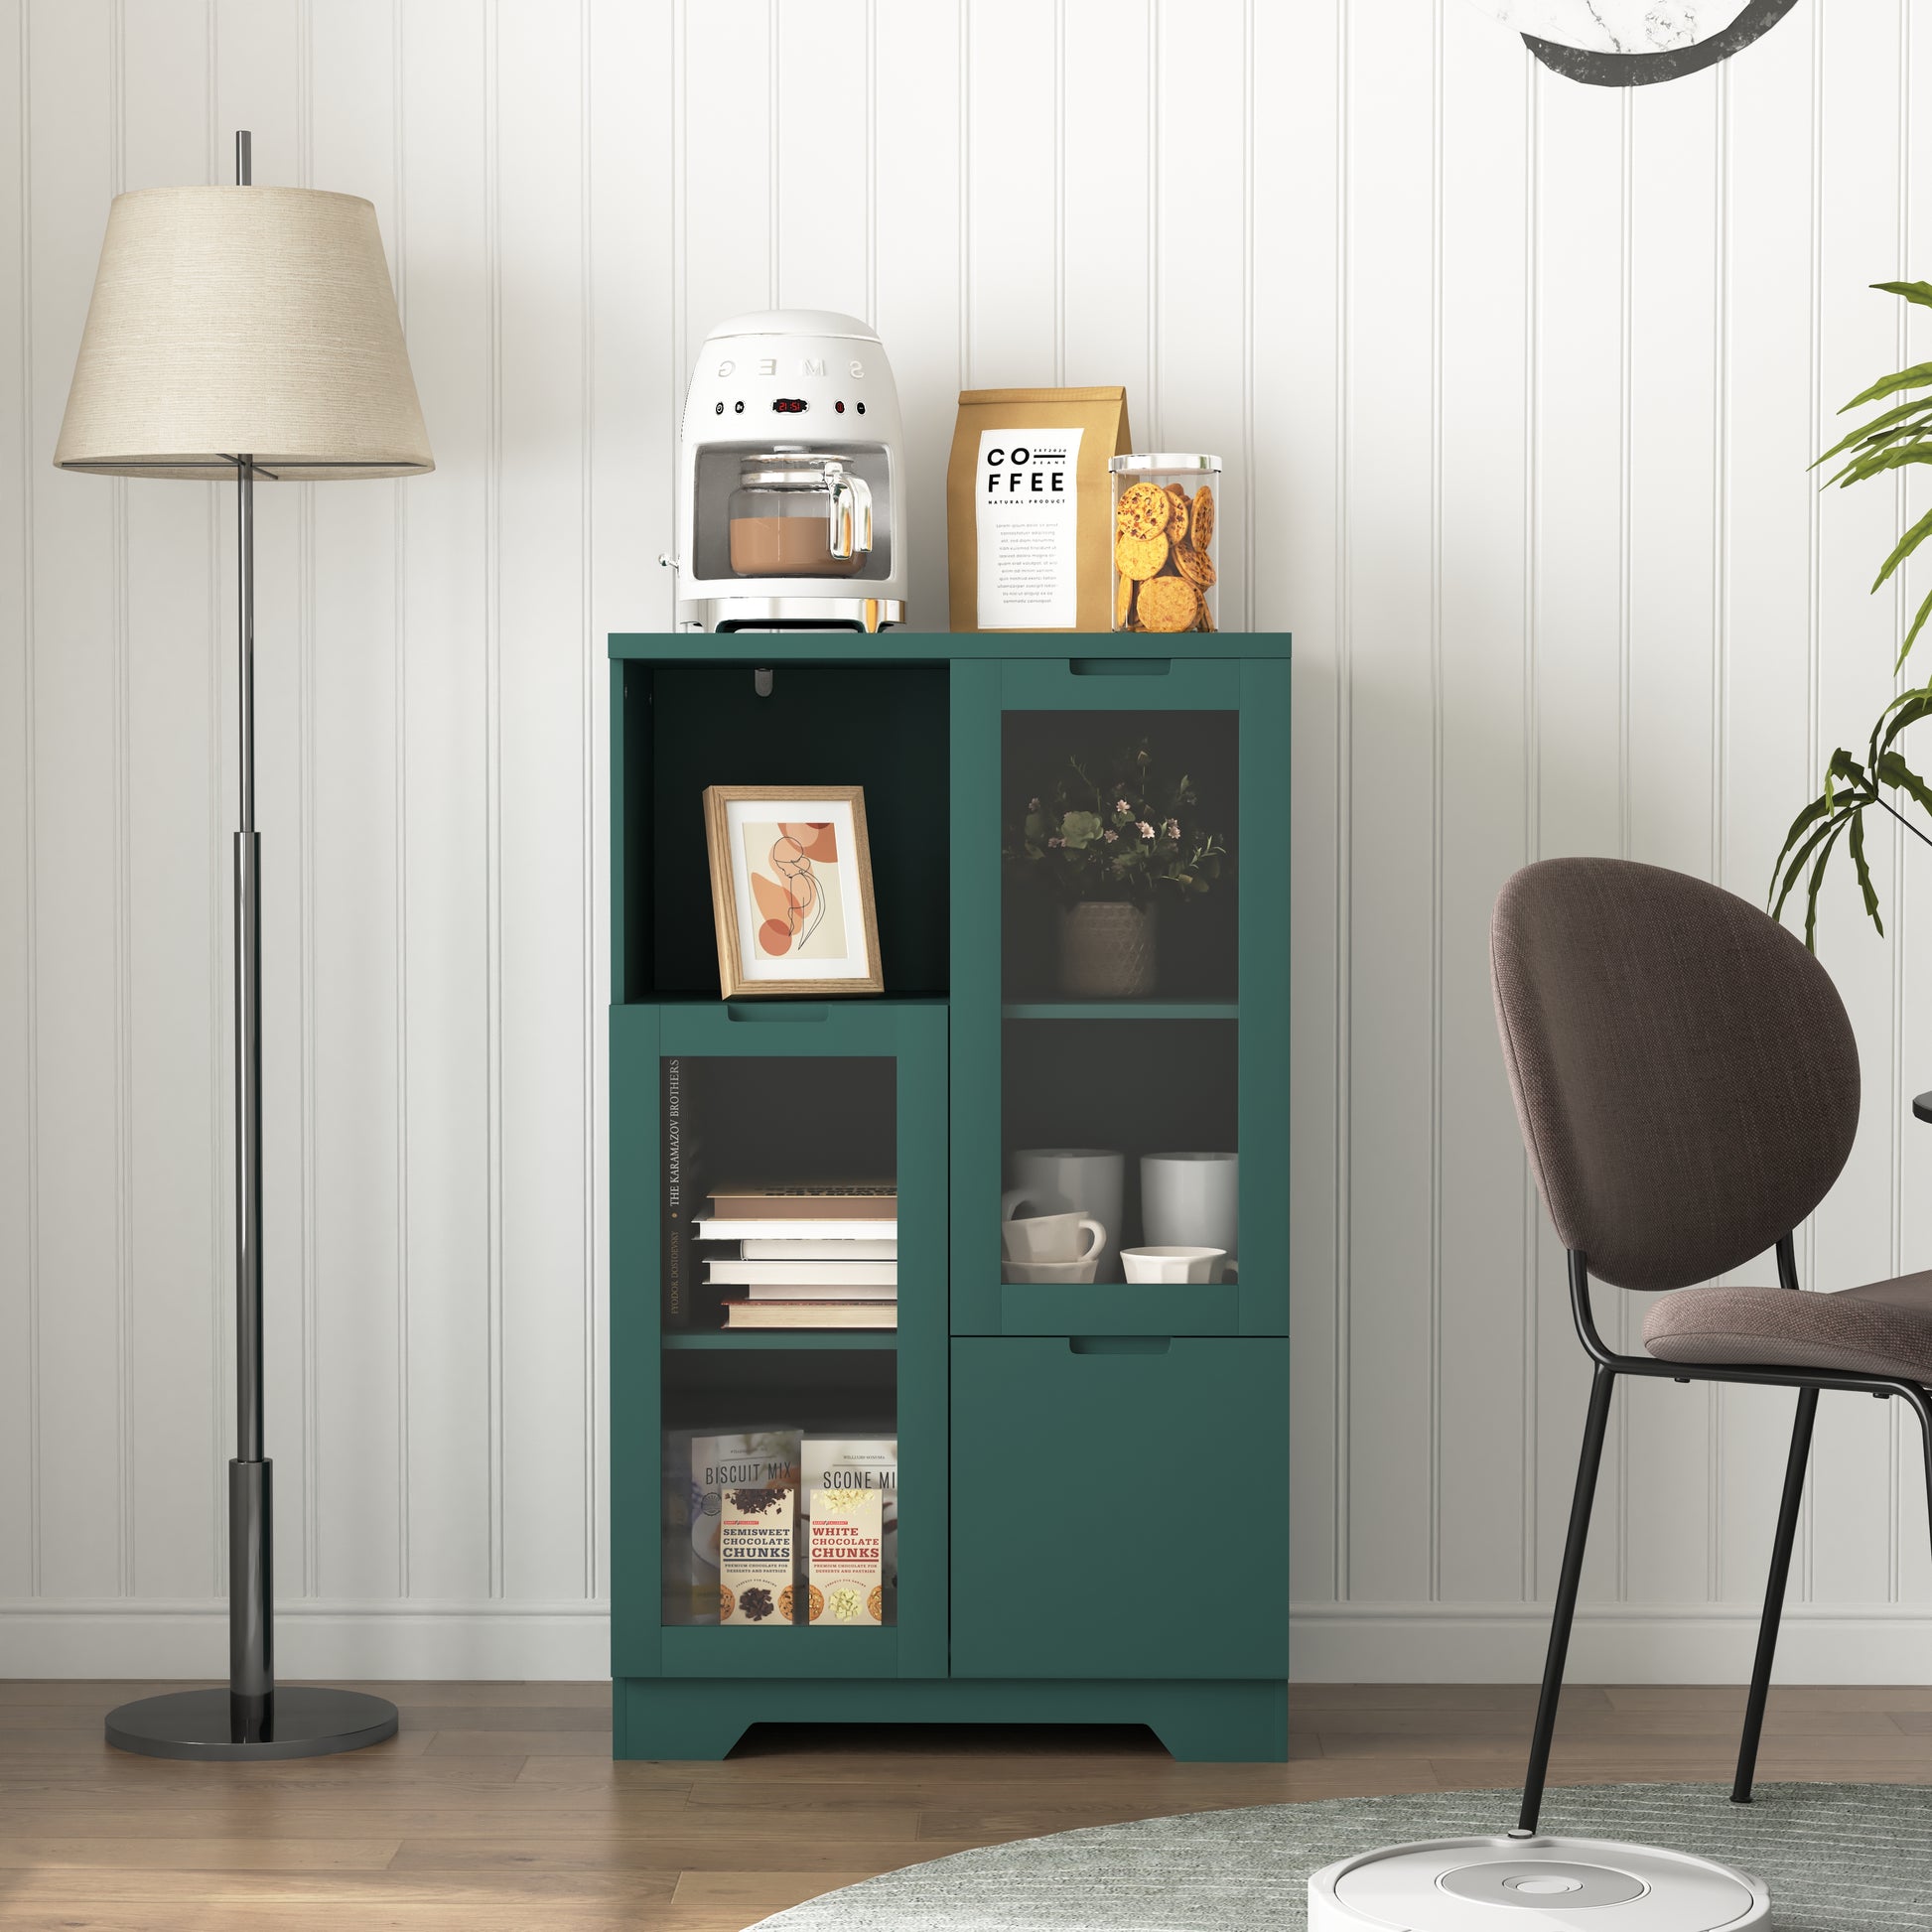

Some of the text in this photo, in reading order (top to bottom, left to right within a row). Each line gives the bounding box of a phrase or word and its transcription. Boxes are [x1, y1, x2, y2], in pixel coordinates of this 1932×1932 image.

[987, 447, 1031, 468] CO
[988, 472, 1064, 493] FFEE
[669, 1059, 680, 1117] BROTHERS
[669, 1119, 680, 1183] KARAMAZOV
[669, 1185, 680, 1207] THE
[705, 1461, 792, 1485] BISCUIT MIX
[823, 1471, 873, 1489] SCONE
[812, 1527, 859, 1536] WHITE
[723, 1548, 790, 1558] CHUNKS
[812, 1548, 880, 1558] CHUNKS
